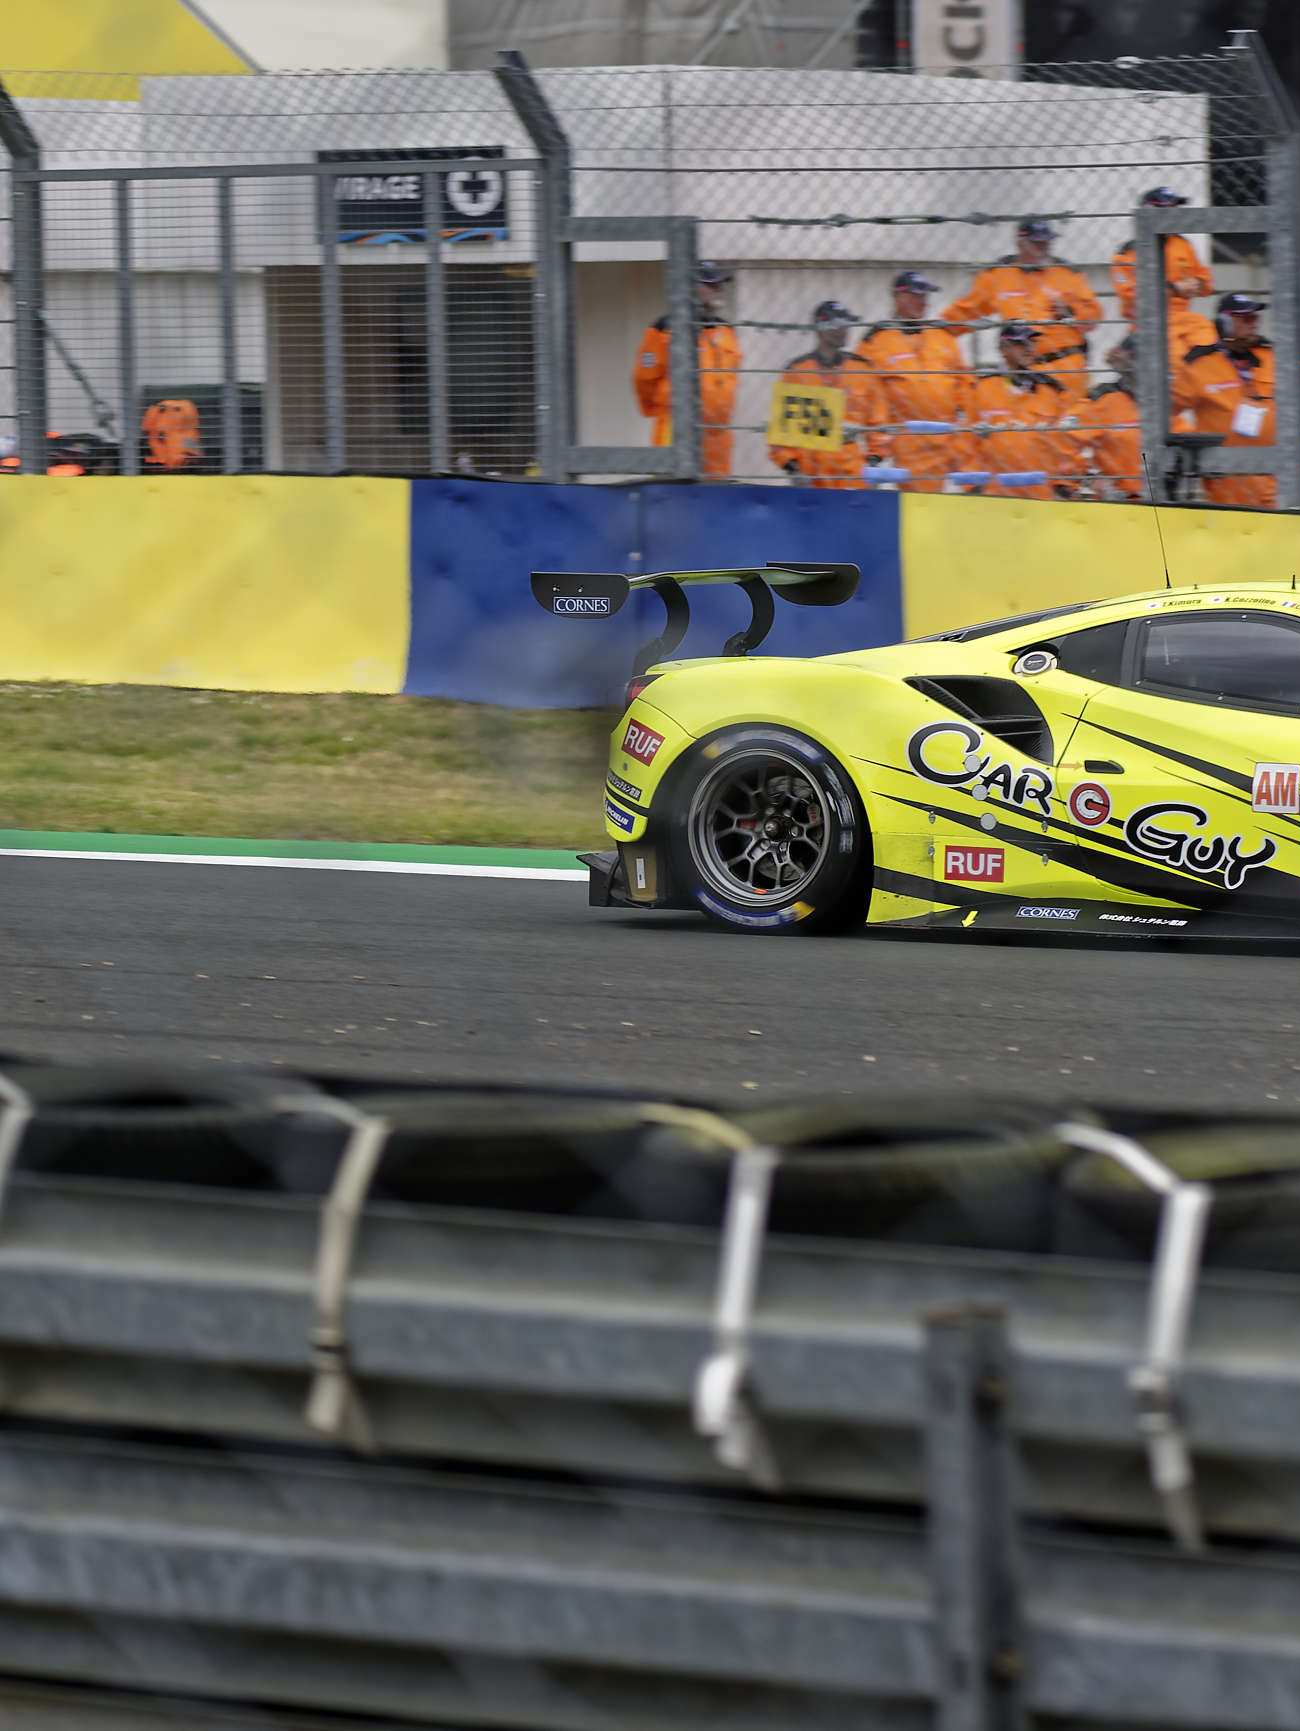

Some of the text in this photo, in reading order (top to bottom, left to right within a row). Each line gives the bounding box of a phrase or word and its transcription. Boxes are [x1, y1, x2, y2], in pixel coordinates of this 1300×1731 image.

[556, 598, 608, 612] CORNES
[624, 725, 661, 758] RUF
[1255, 771, 1297, 807] AM
[946, 851, 1002, 877] RUF
[1020, 907, 1076, 918] CORNES
